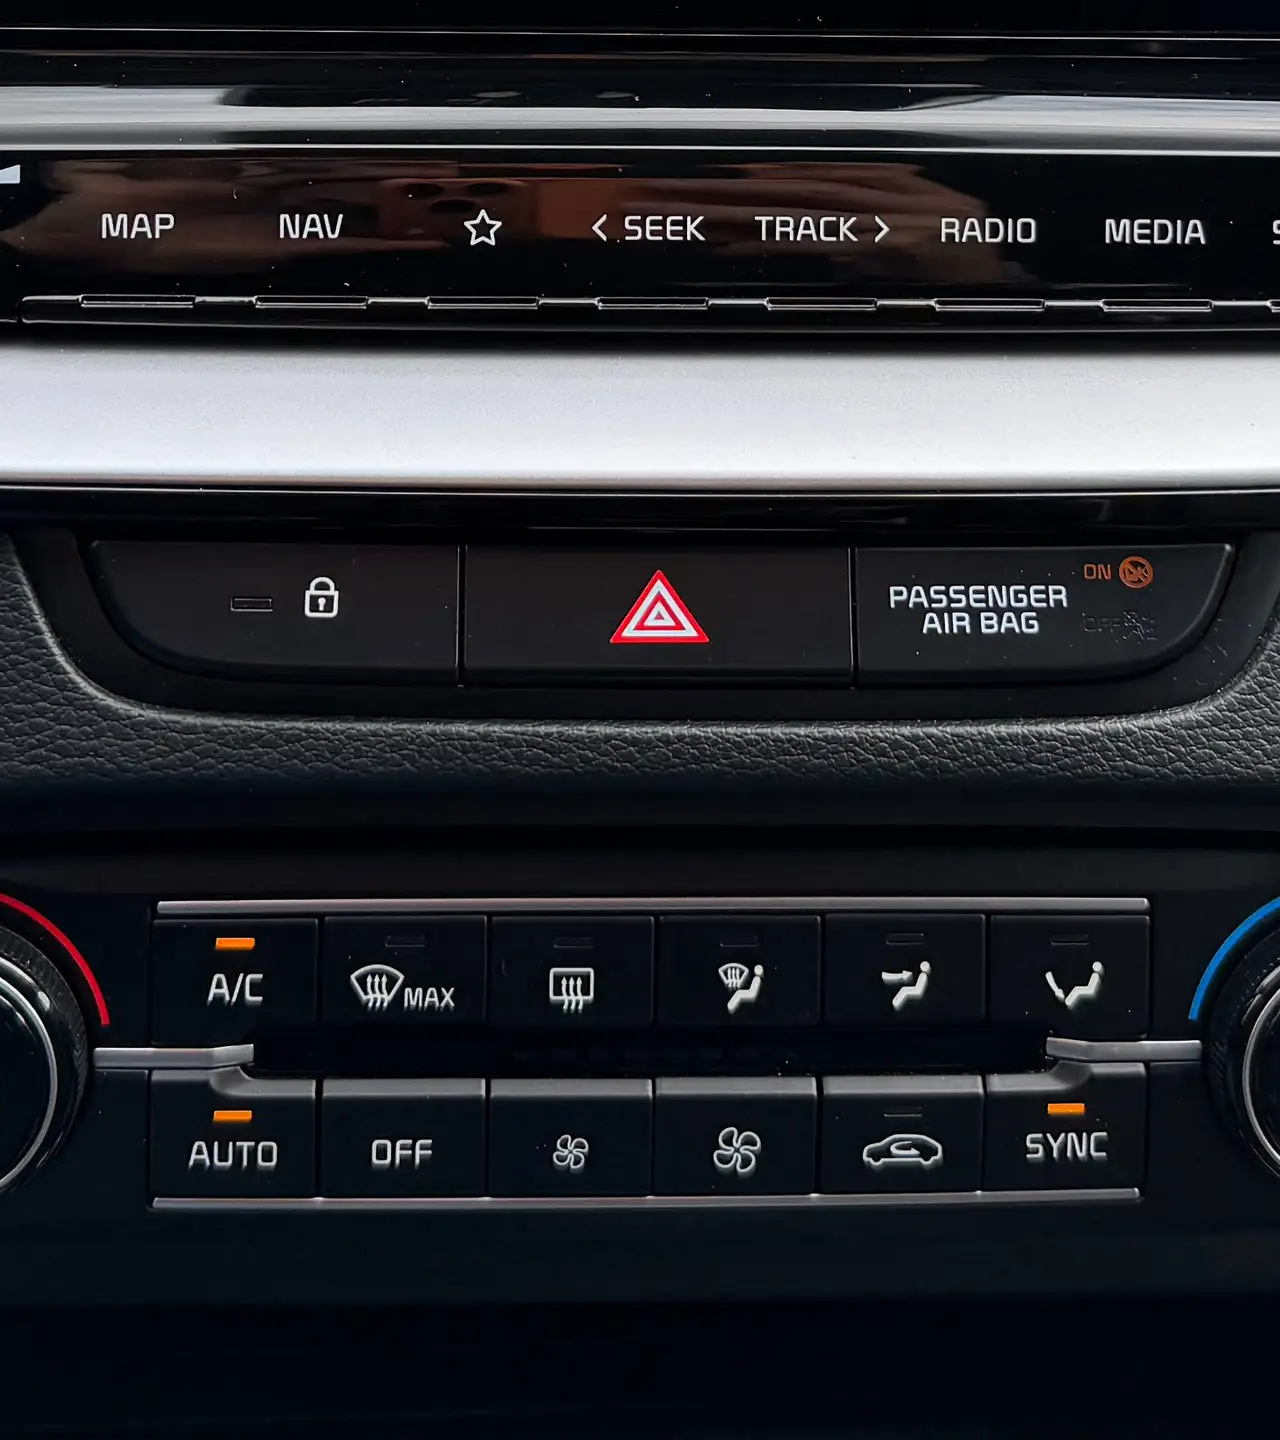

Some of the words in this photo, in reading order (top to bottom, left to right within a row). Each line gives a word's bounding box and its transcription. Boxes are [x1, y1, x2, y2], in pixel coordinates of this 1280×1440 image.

[100, 212, 176, 240] MAP
[278, 212, 345, 240] NAV
[623, 214, 706, 242] SEEK
[754, 215, 858, 243] TRACK
[940, 216, 1037, 244] RADIO
[1104, 217, 1207, 246] MEDIA
[1083, 563, 1112, 580] ON
[888, 584, 1069, 609] PASSENGER
[922, 611, 972, 635] AIR
[979, 611, 1040, 635] BAG
[206, 972, 264, 1004] A/C
[403, 986, 456, 1010] MAX
[187, 1140, 279, 1169] AUTO
[370, 1138, 434, 1167] OFF
[1025, 1130, 1109, 1162] SYNC
